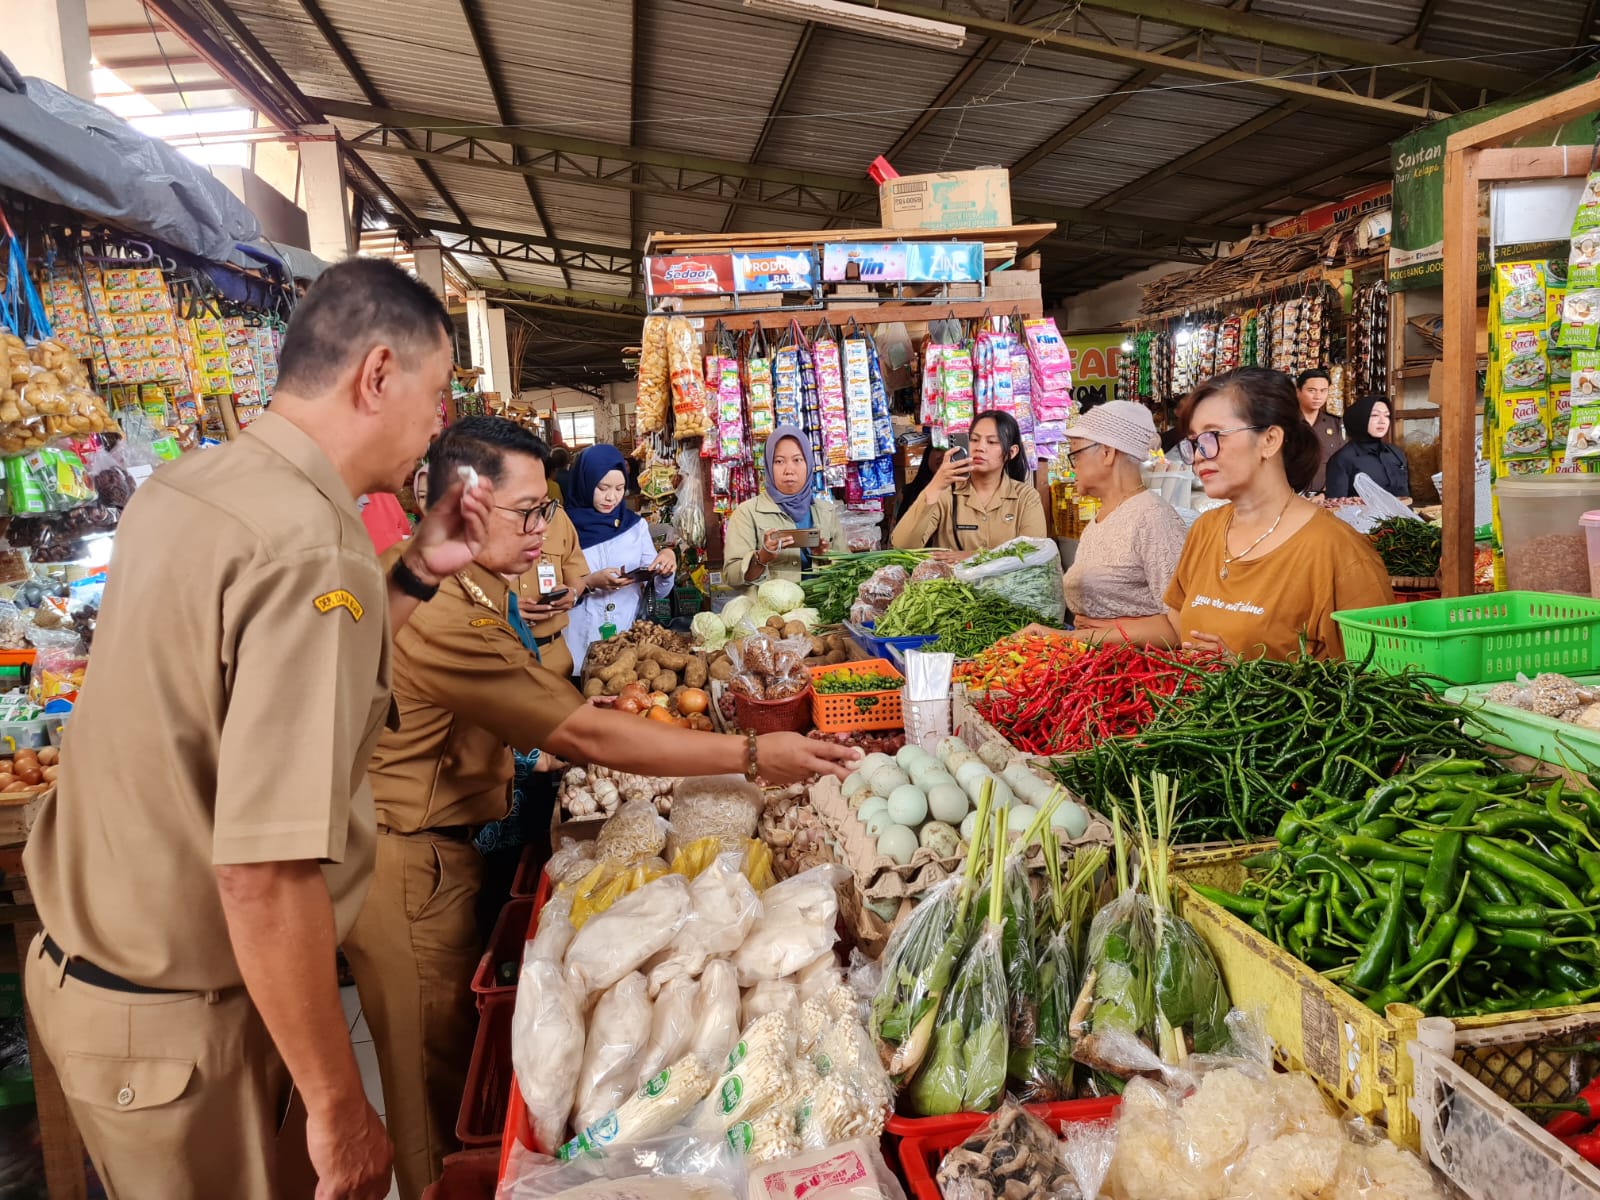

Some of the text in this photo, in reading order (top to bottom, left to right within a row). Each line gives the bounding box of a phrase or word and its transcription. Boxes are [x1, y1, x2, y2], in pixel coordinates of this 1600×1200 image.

[1396, 144, 1441, 171] Santan
[745, 260, 792, 273] PRODU
[773, 275, 800, 284] BARU
[1510, 337, 1538, 352] Racik
[1512, 404, 1539, 419] Racik
[1555, 399, 1571, 411] Rac
[1191, 594, 1211, 608] you
